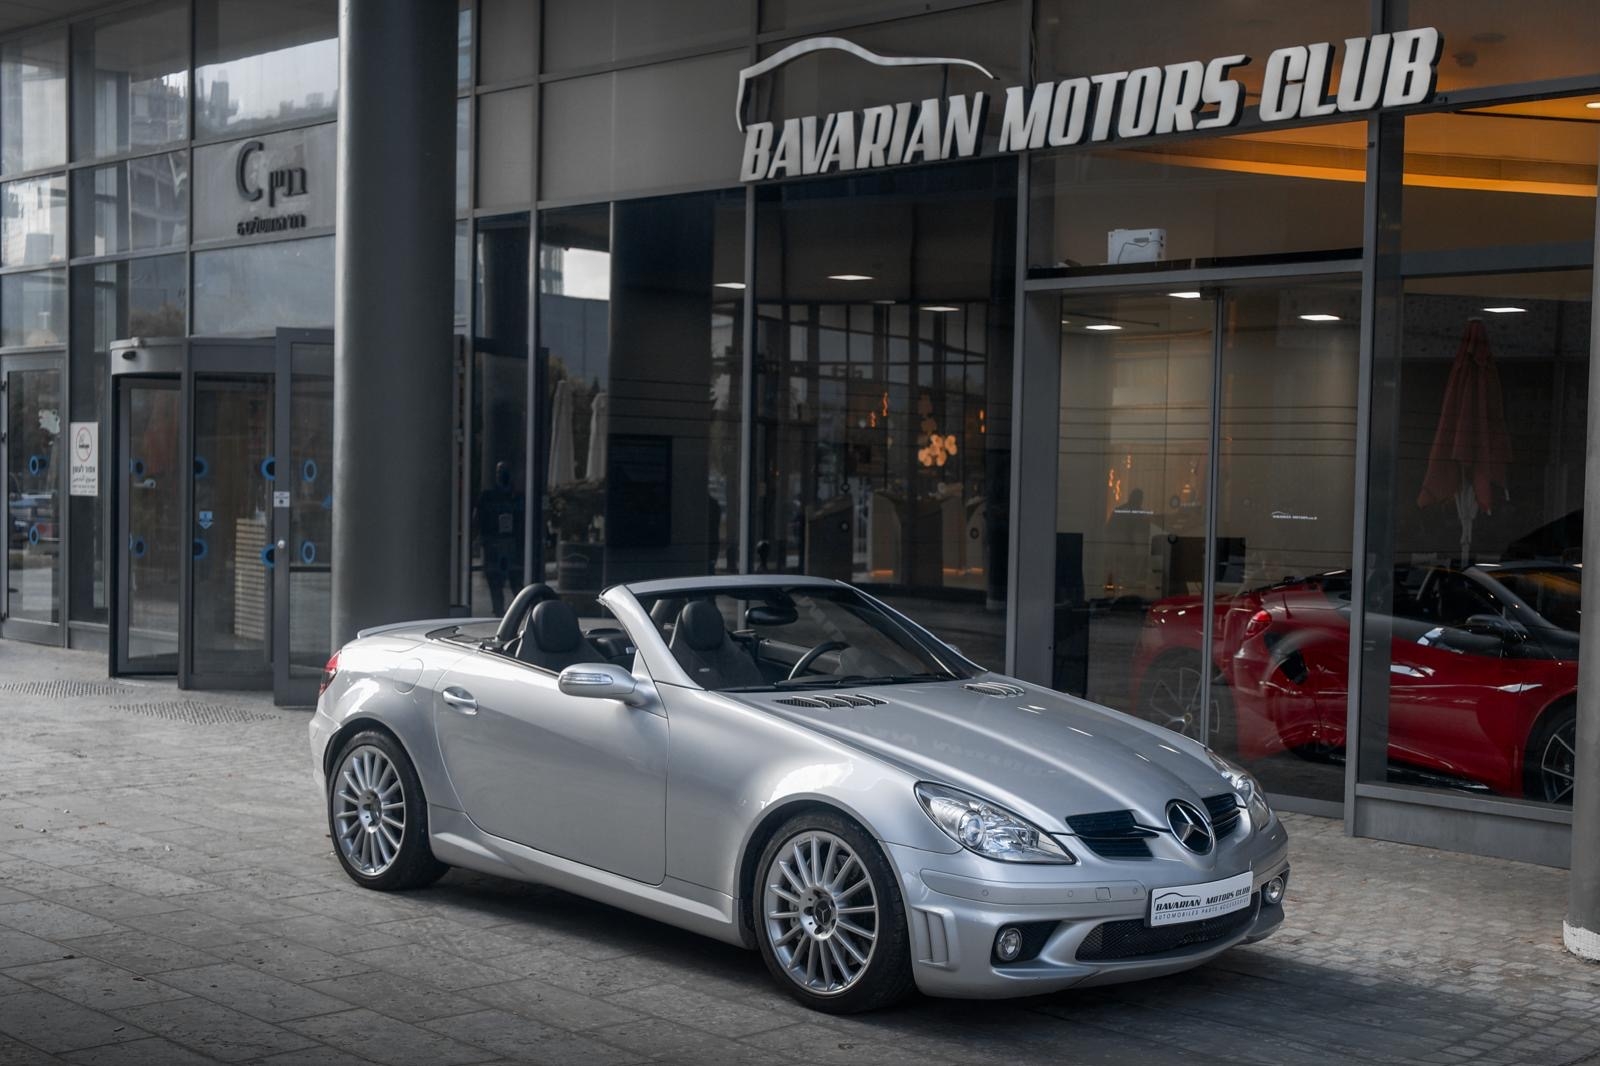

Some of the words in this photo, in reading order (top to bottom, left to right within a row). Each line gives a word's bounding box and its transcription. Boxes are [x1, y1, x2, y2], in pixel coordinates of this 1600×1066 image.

[739, 91, 986, 182] BAVARIAN
[998, 54, 1251, 153] MOTORS
[1259, 26, 1442, 123] CLUB
[236, 141, 264, 202] C
[1154, 910, 1199, 920] AUTOMOBILES
[1155, 899, 1201, 911] BAVARIAN
[1206, 892, 1235, 904] MOTORS
